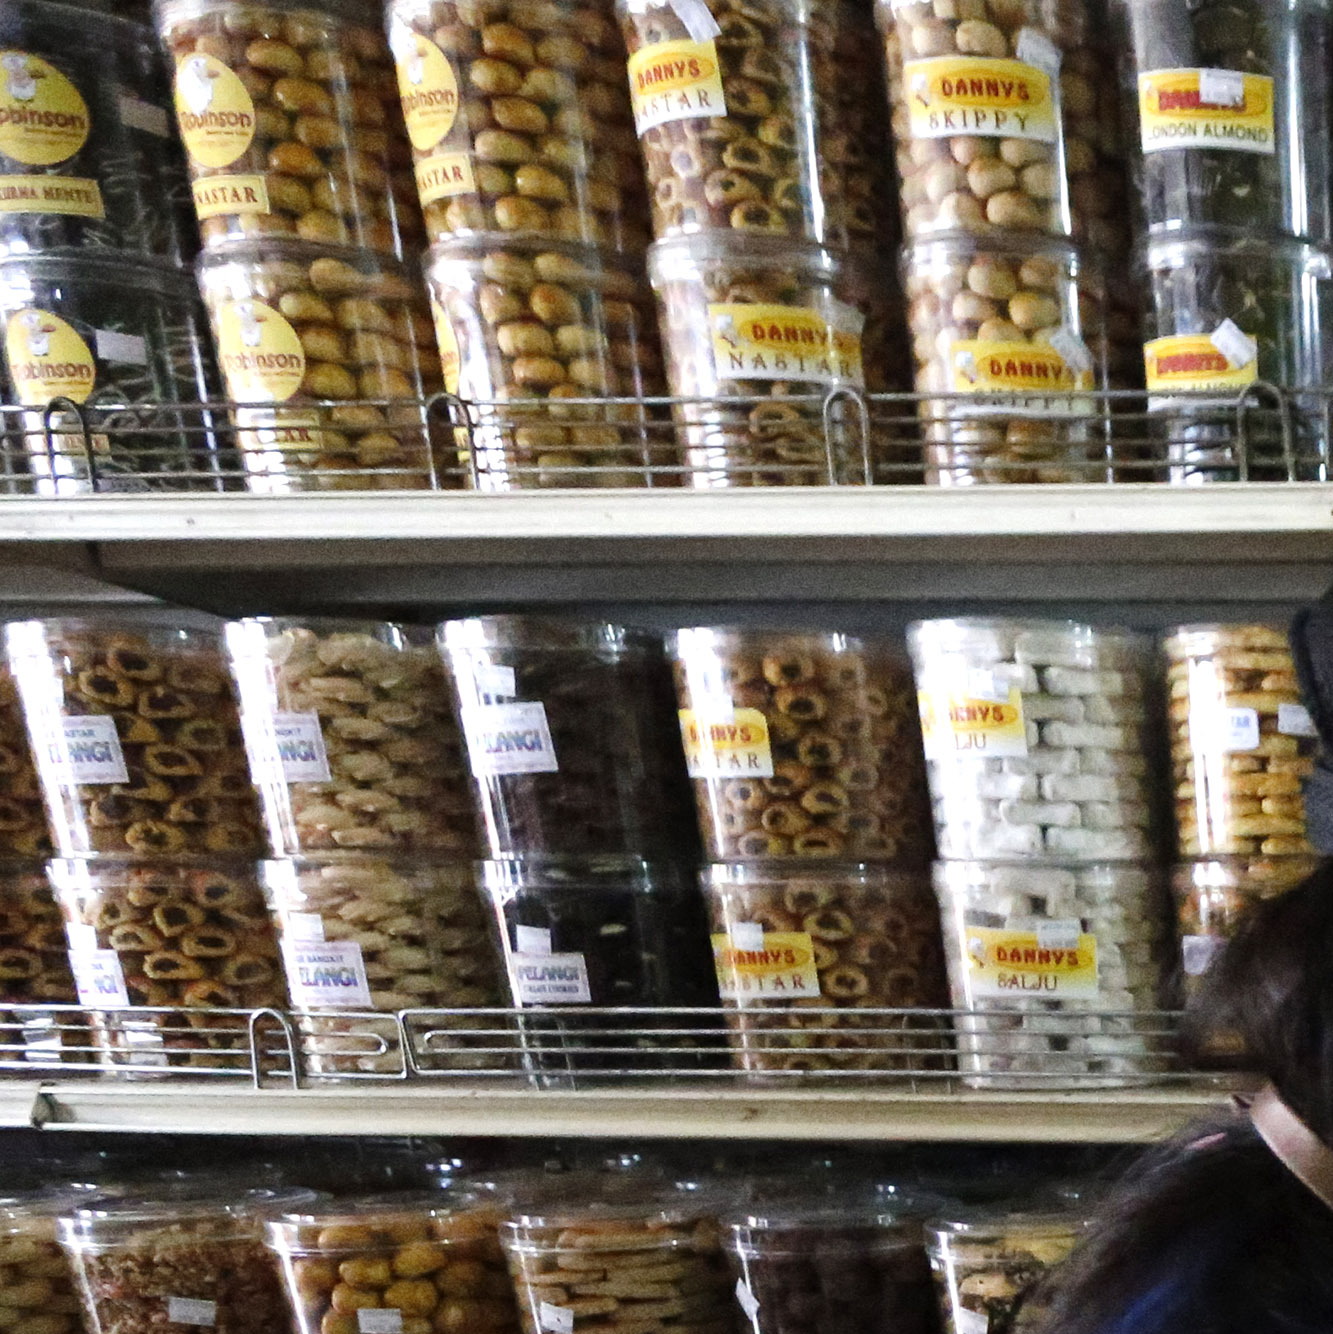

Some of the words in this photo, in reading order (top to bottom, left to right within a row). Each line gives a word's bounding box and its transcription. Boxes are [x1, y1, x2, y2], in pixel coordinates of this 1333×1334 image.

[637, 58, 702, 90] DANNYS
[941, 76, 1031, 102] DANNYS
[0, 108, 87, 129] obinson
[929, 109, 1029, 134] SKIPPY
[1203, 122, 1271, 144] ALMOND
[0, 184, 38, 201] URMA
[420, 172, 465, 191] ASTAR
[989, 356, 1064, 382] DANNY
[995, 944, 1080, 967] DANNYS
[996, 972, 1059, 992] SALJU
